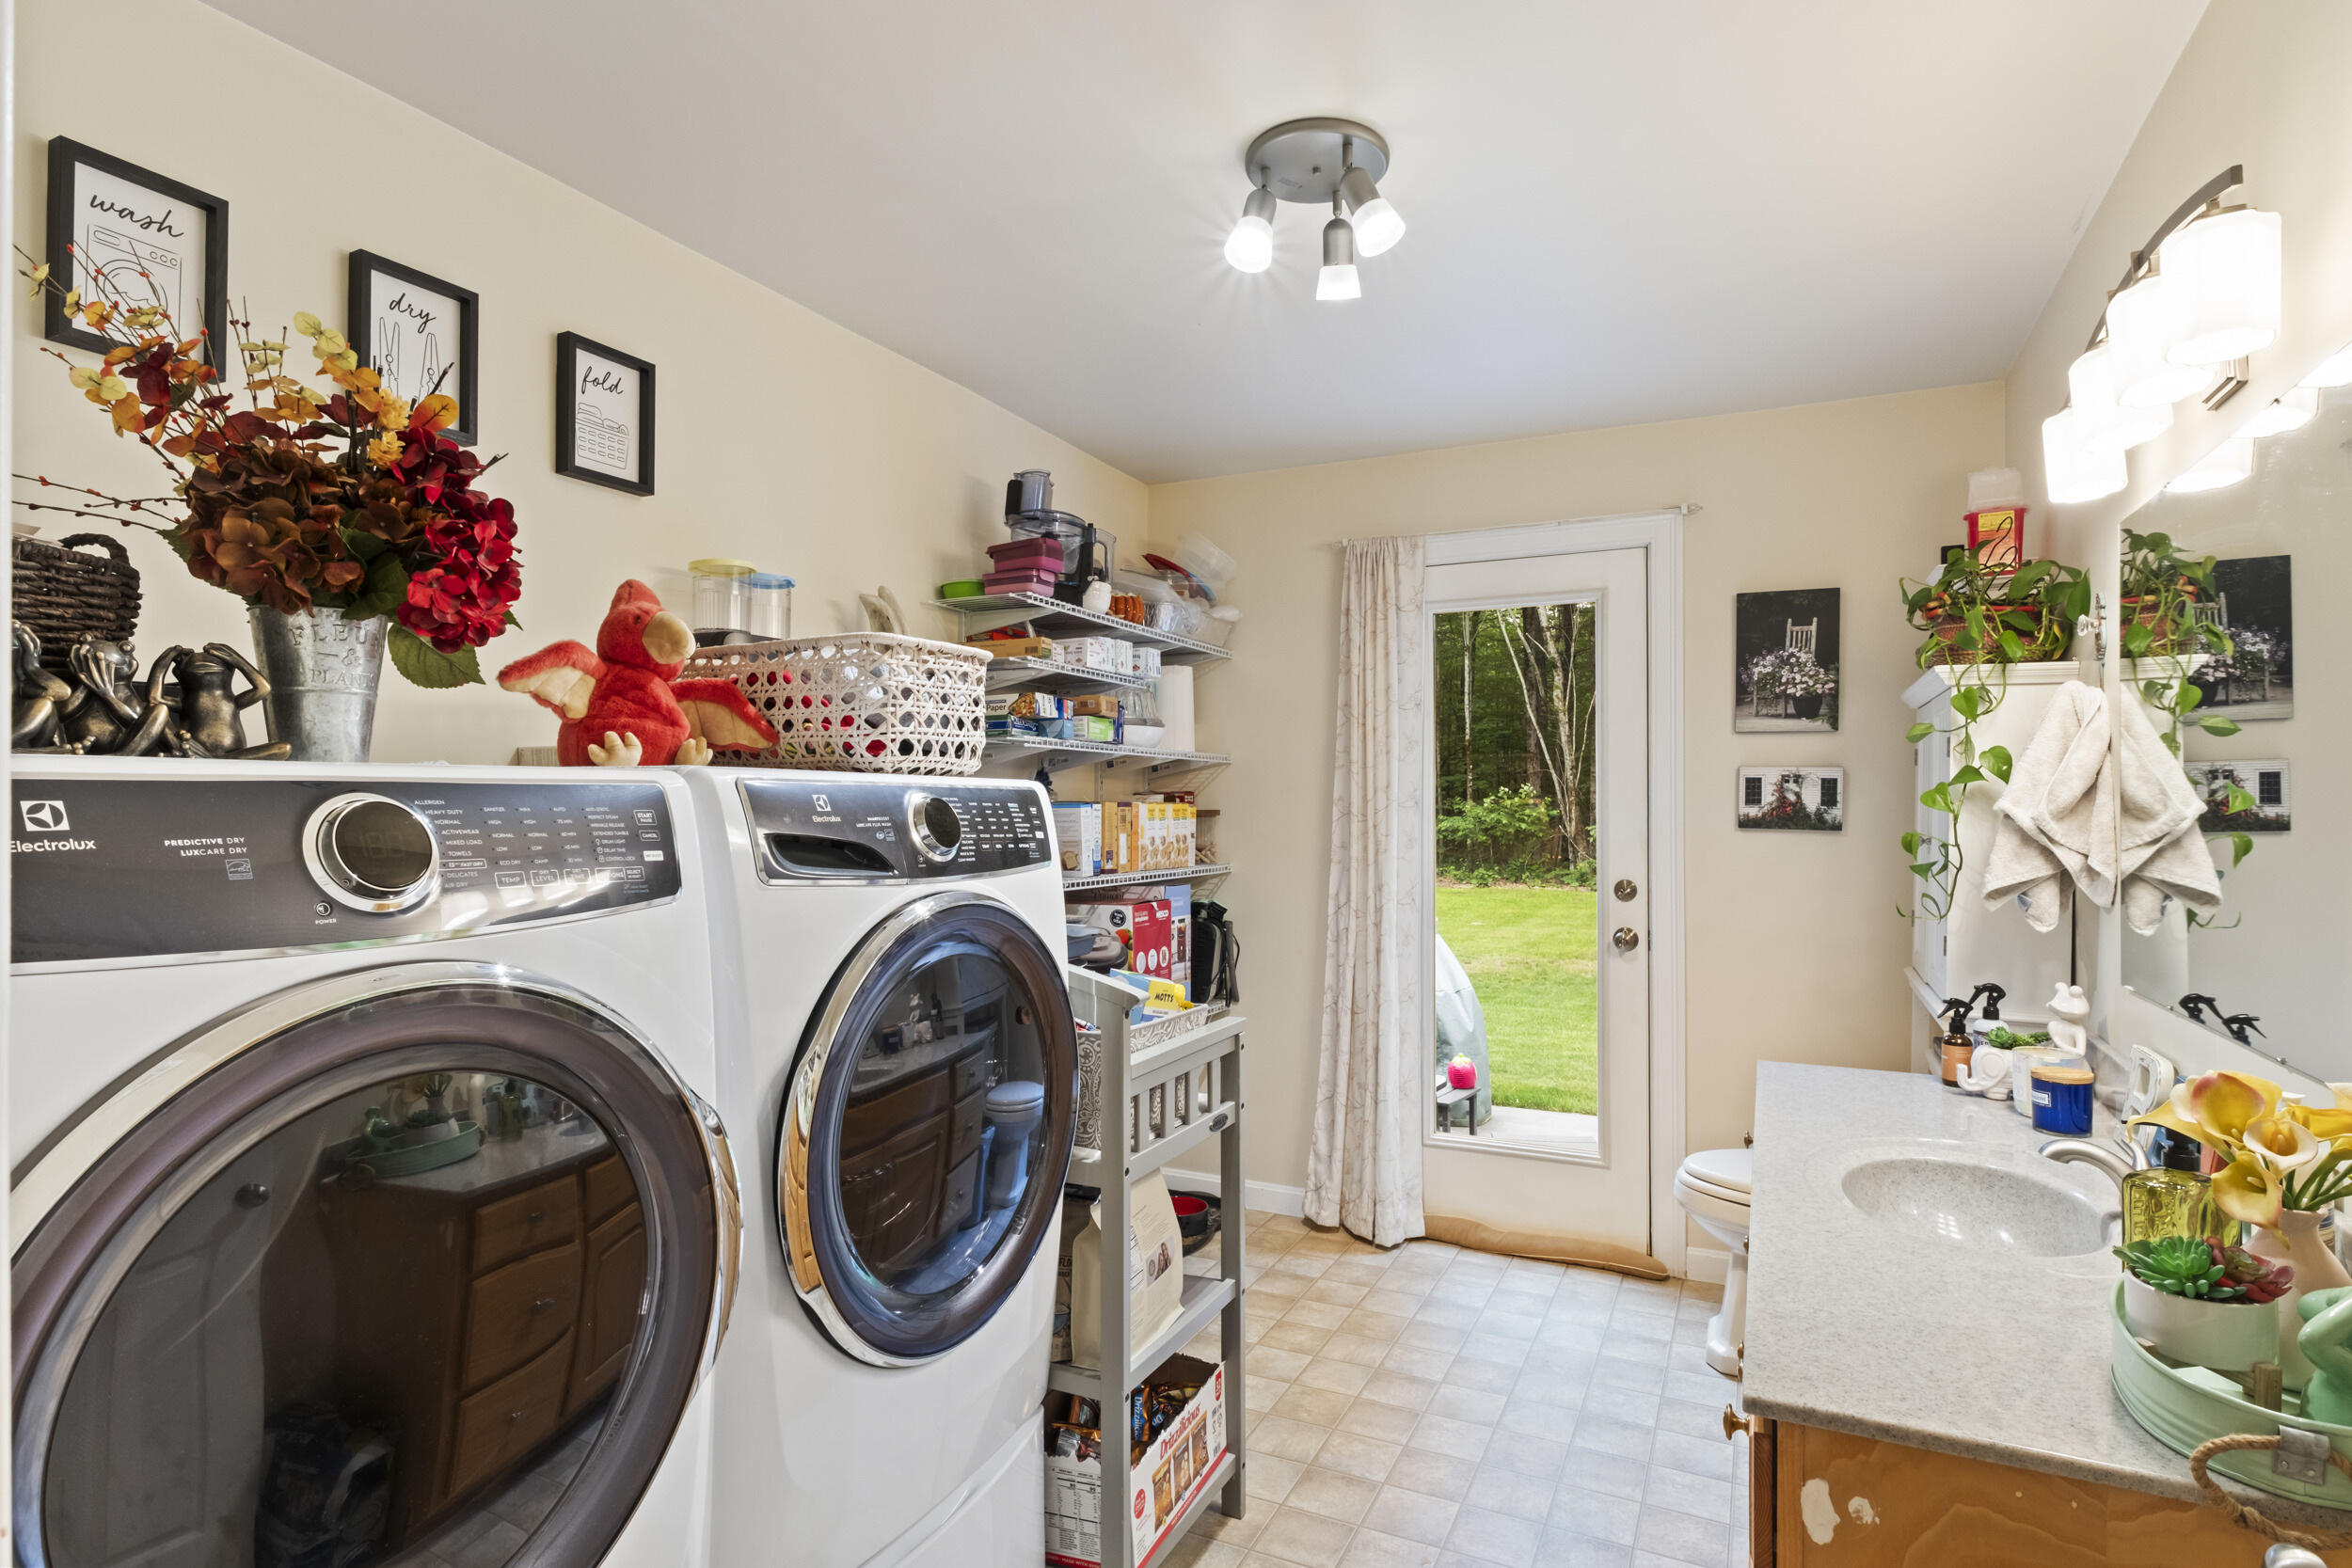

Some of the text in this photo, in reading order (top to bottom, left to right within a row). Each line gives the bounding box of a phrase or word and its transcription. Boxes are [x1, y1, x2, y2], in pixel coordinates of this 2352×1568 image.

[89, 194, 184, 237] wash
[389, 293, 437, 334] dry
[581, 366, 624, 394] fold
[986, 704, 1007, 712] Paper
[10, 839, 97, 853] Electrolux
[165, 838, 223, 847] PREDICTIVE
[181, 847, 225, 857] LUXCARE
